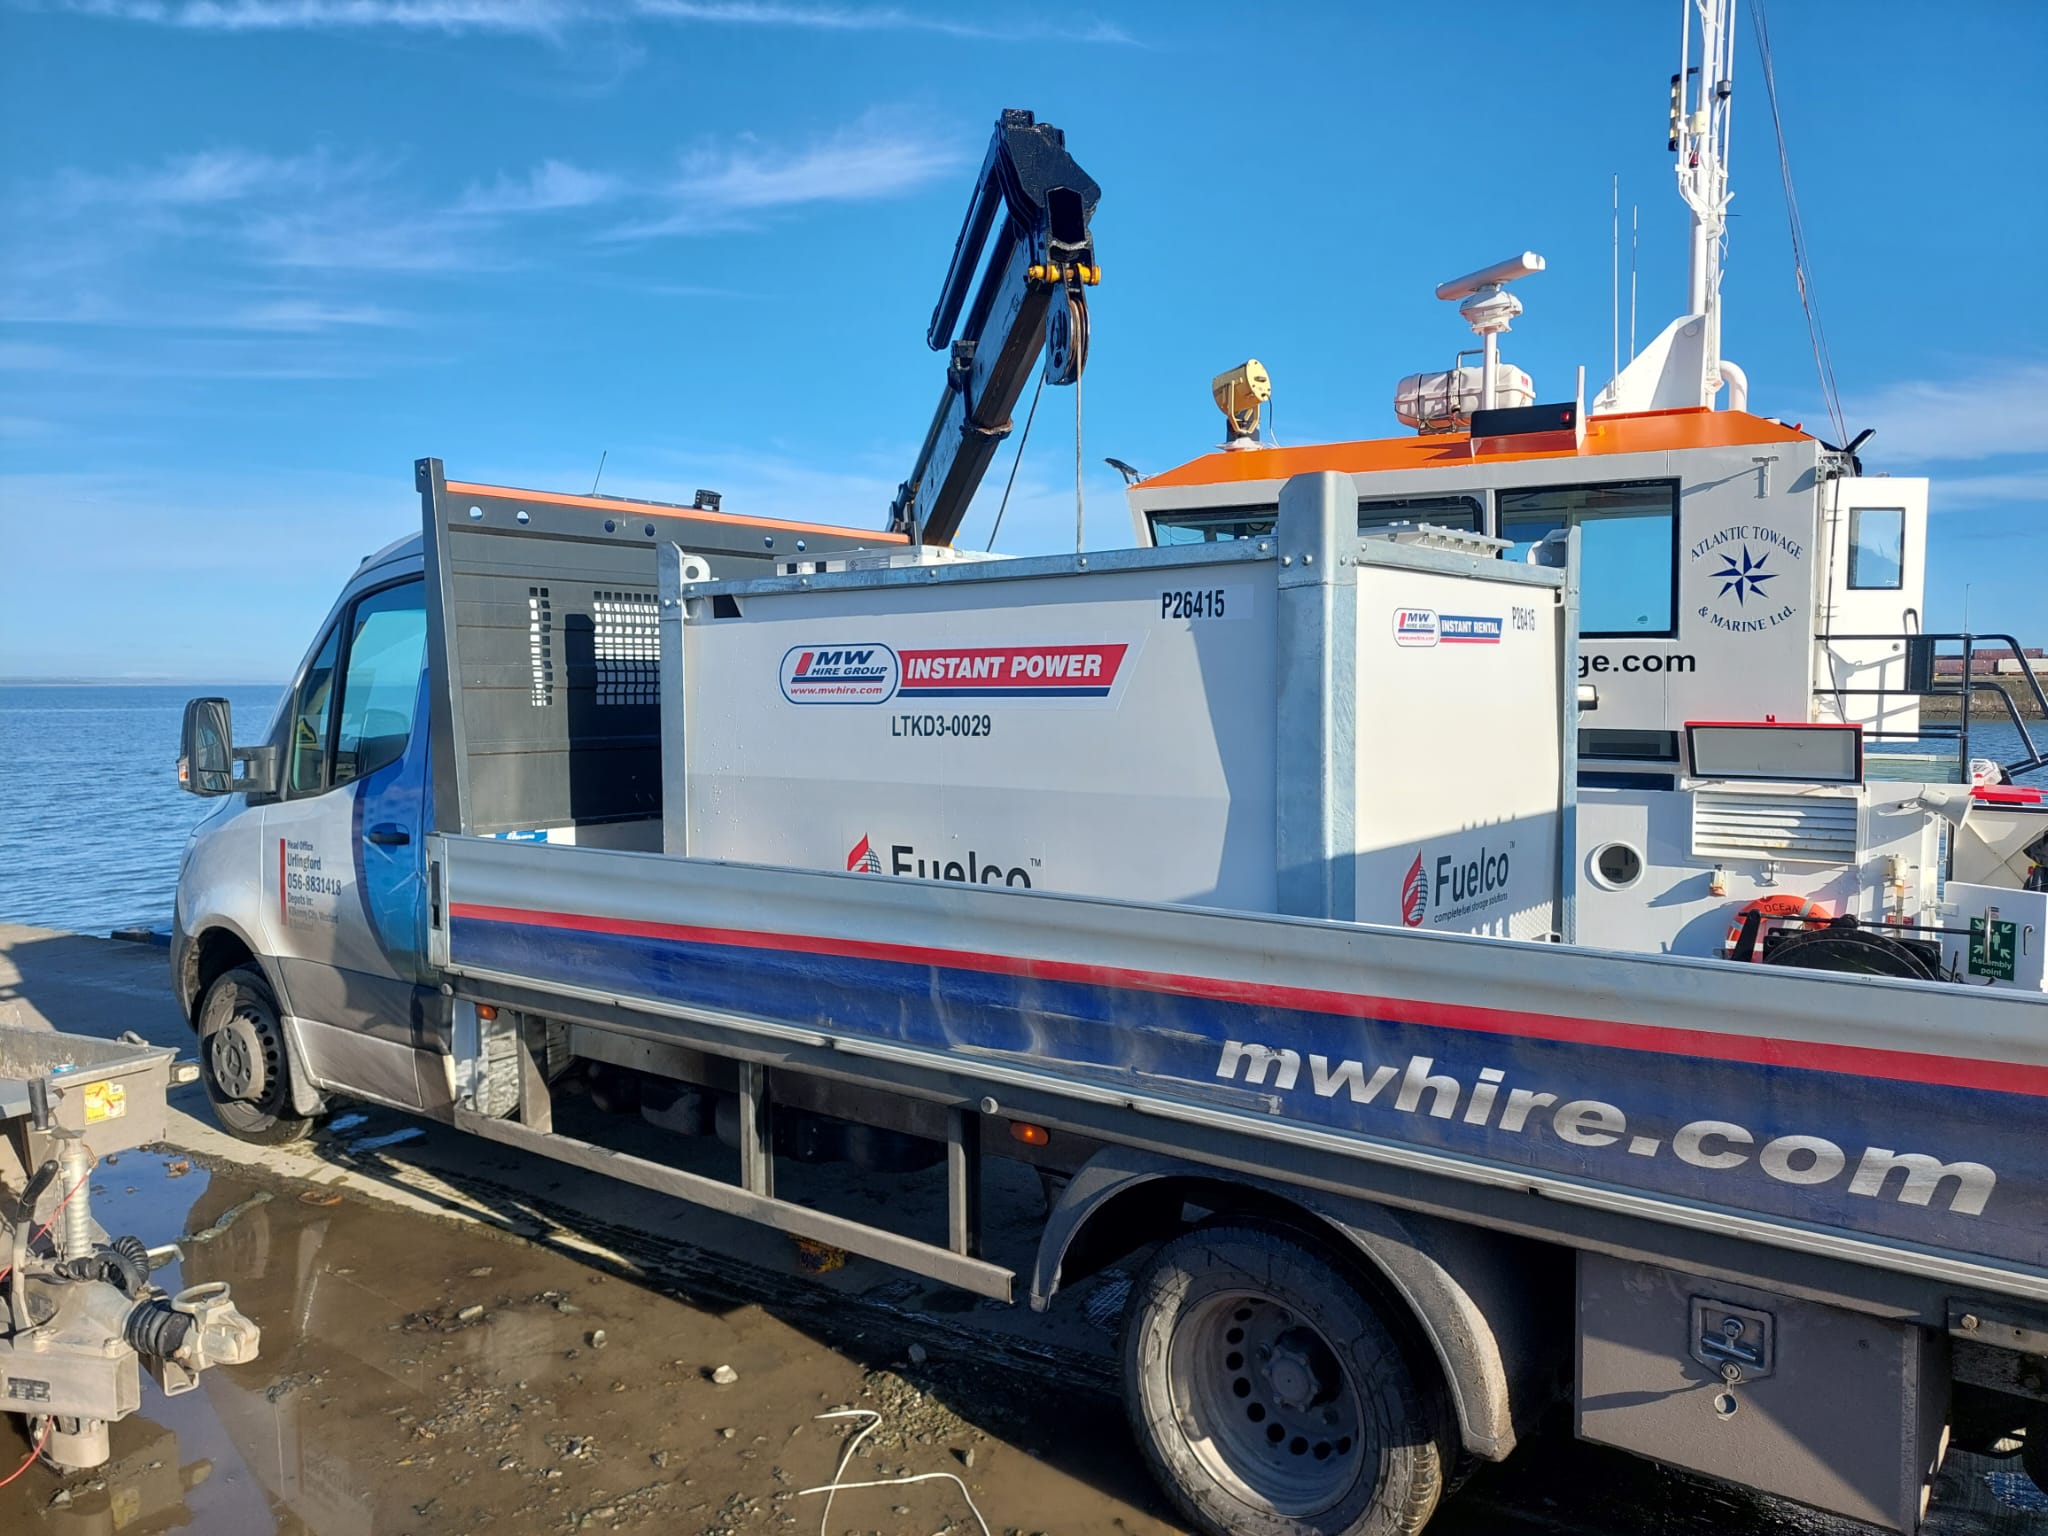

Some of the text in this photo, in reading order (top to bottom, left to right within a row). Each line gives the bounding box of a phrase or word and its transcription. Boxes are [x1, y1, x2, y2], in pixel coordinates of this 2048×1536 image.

[1690, 525, 1803, 562] ATLANTIC TOWAGE
[1161, 589, 1225, 620] P26415
[1407, 612, 1430, 623] MW
[1441, 619, 1499, 634] INSTANT RENTAL
[1511, 606, 1536, 632] P26415
[1698, 606, 1797, 632] & MARINE Ltd.
[815, 650, 875, 666] MW
[907, 654, 1102, 680] INSTANT POWER
[811, 666, 888, 676] HIRE GROUP
[790, 686, 882, 695] www.mwhire.com
[891, 714, 992, 737] LTKD3-0029
[287, 852, 321, 872] Urlingford
[287, 872, 342, 896] 056-8831418
[1434, 846, 1510, 907] Fuelco
[1433, 906, 1461, 923] complete
[1980, 967, 2002, 977] point
[1214, 1038, 1998, 1217] mwhire.com
